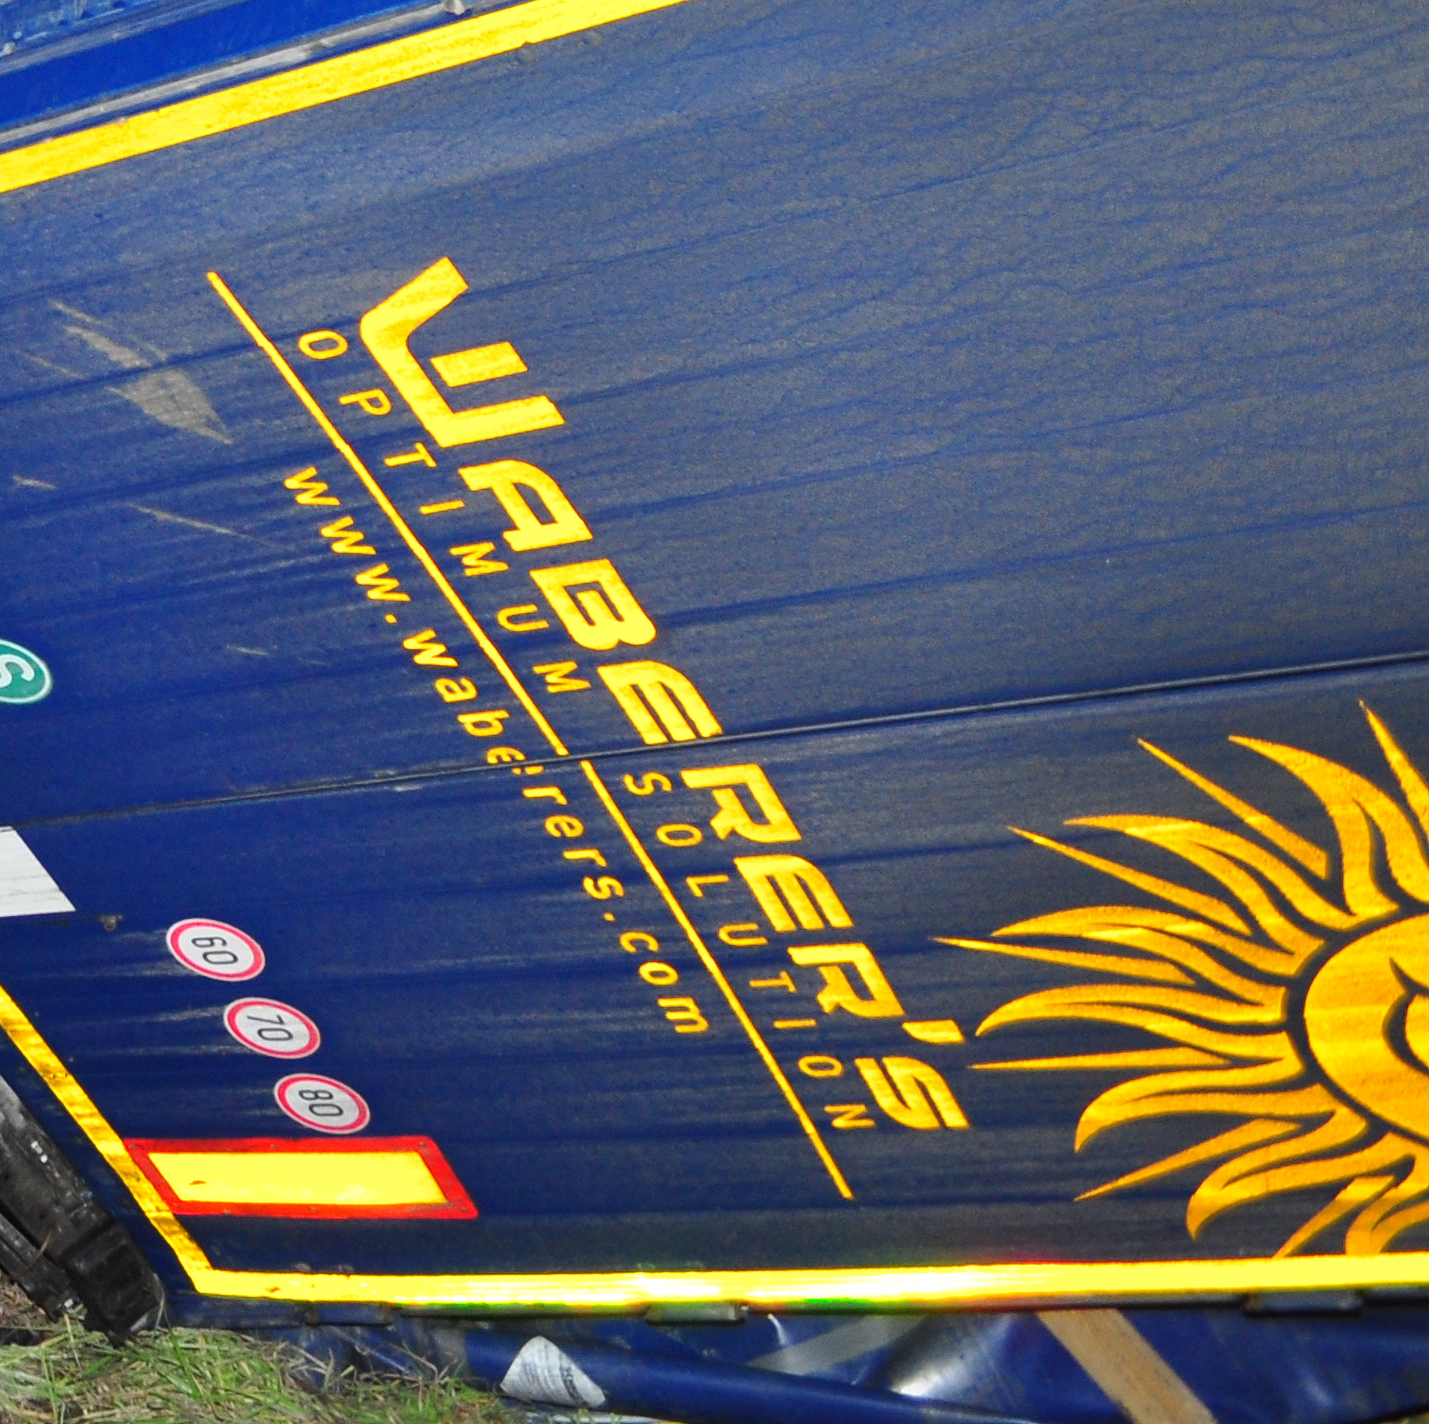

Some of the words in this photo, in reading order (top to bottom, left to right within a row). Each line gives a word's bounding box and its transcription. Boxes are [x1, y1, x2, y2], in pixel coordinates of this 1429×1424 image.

[360, 257, 969, 1129] WABERER'S
[297, 329, 592, 696] OPTIMUM
[622, 770, 878, 1131] SOLUTION
[191, 935, 239, 967] 60
[246, 1012, 294, 1044] 70
[298, 1087, 344, 1119] 80
